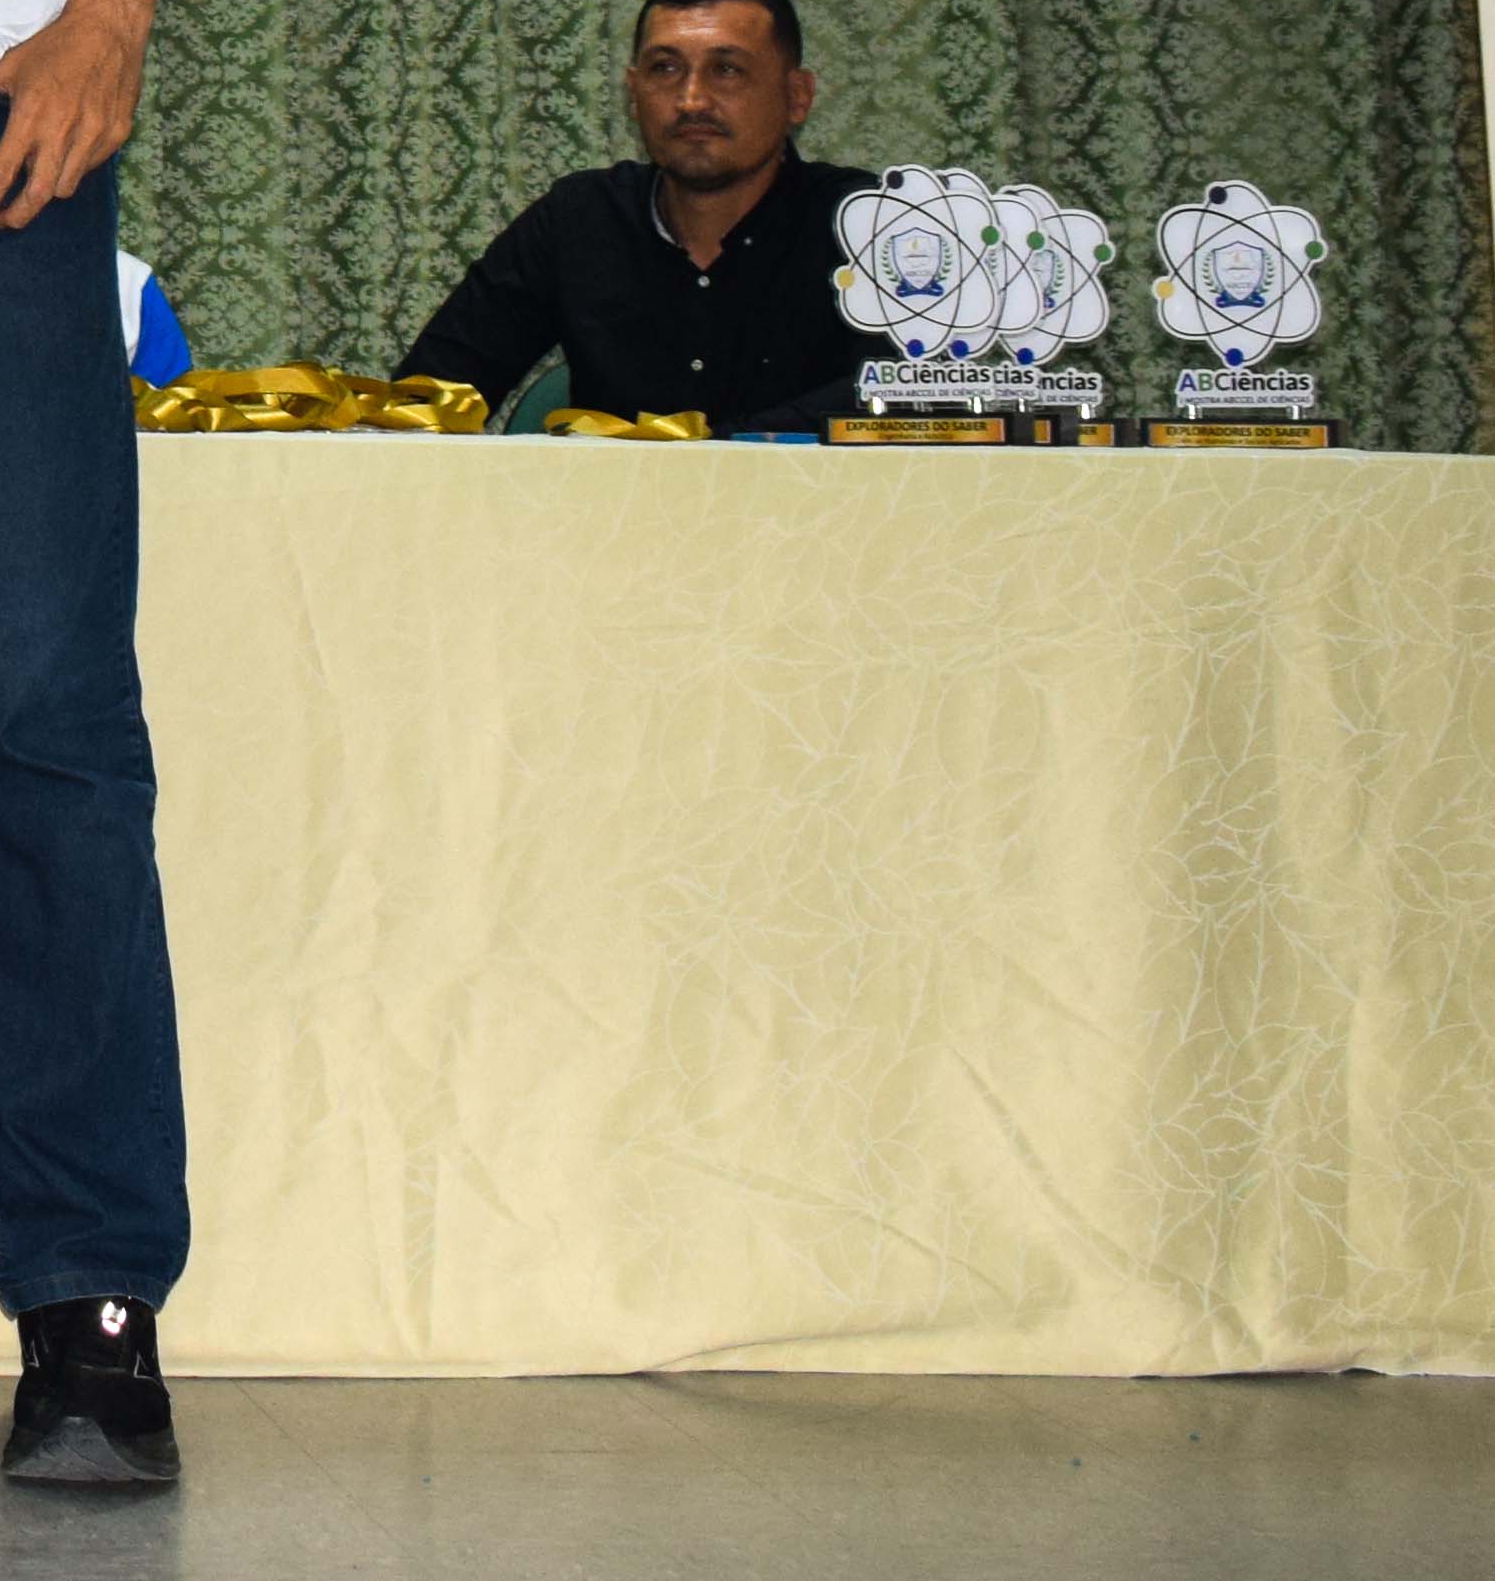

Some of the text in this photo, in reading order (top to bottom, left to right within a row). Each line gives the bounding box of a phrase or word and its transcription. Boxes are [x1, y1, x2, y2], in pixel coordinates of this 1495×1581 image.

[863, 362, 991, 386] ABCiências
[1178, 371, 1310, 392] ABCiências
[932, 422, 949, 432] DO
[1255, 426, 1272, 437] DO
